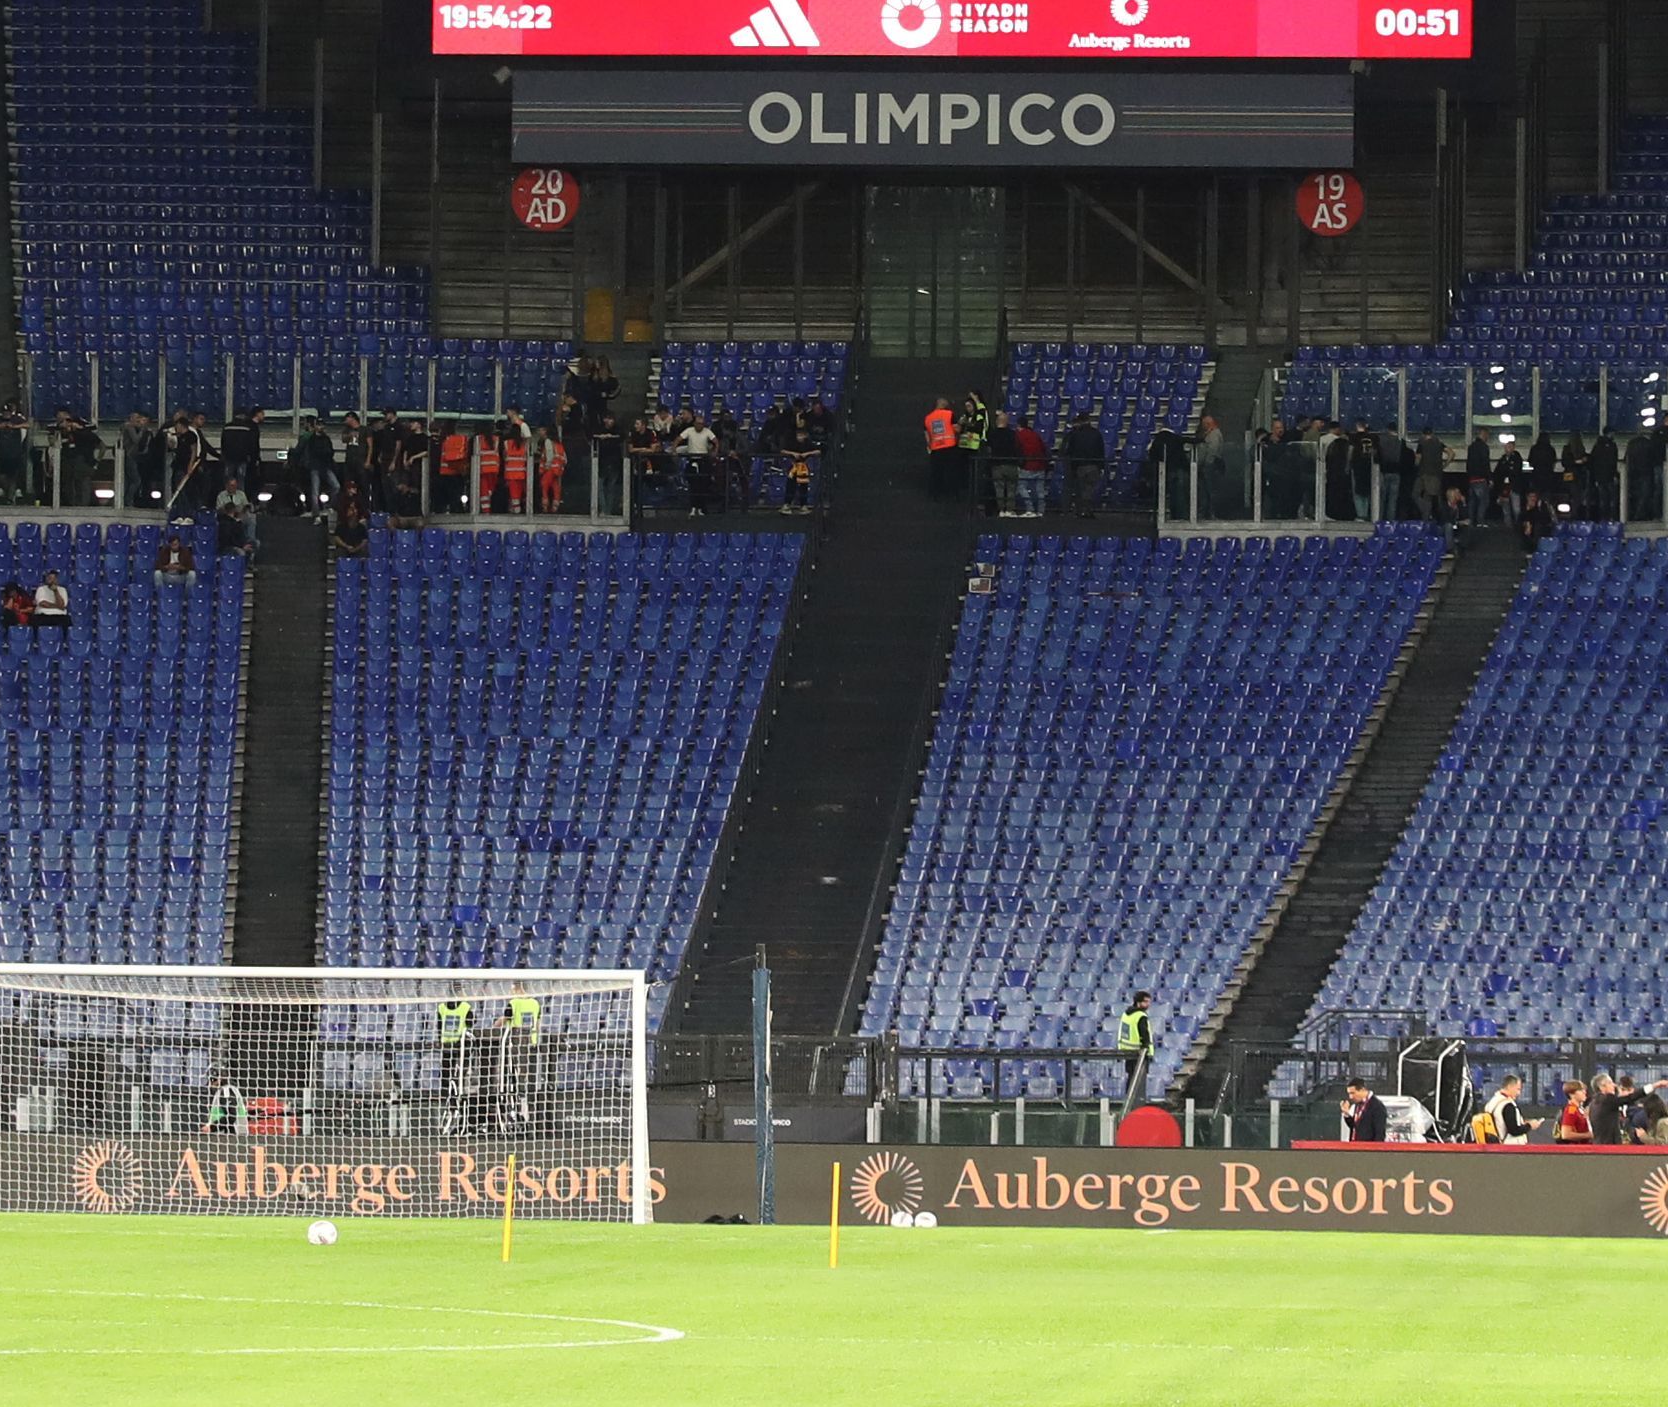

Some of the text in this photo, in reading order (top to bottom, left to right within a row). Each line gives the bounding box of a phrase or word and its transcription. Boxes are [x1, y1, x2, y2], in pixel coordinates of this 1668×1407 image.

[439, 4, 552, 29] 19:54:22
[950, 3, 1027, 17] RIYADH
[1375, 10, 1460, 36] 00:51
[950, 19, 1027, 32] SEASON
[1068, 33, 1190, 51] Auberge Resorts
[748, 90, 1117, 146] OLIMPICO
[531, 169, 563, 195] 20
[1314, 174, 1345, 200] 19
[525, 198, 566, 223] AD
[1312, 203, 1348, 229] AS
[166, 1146, 667, 1214] Auberge Resorts
[945, 1156, 1455, 1226] Auberge Resorts
